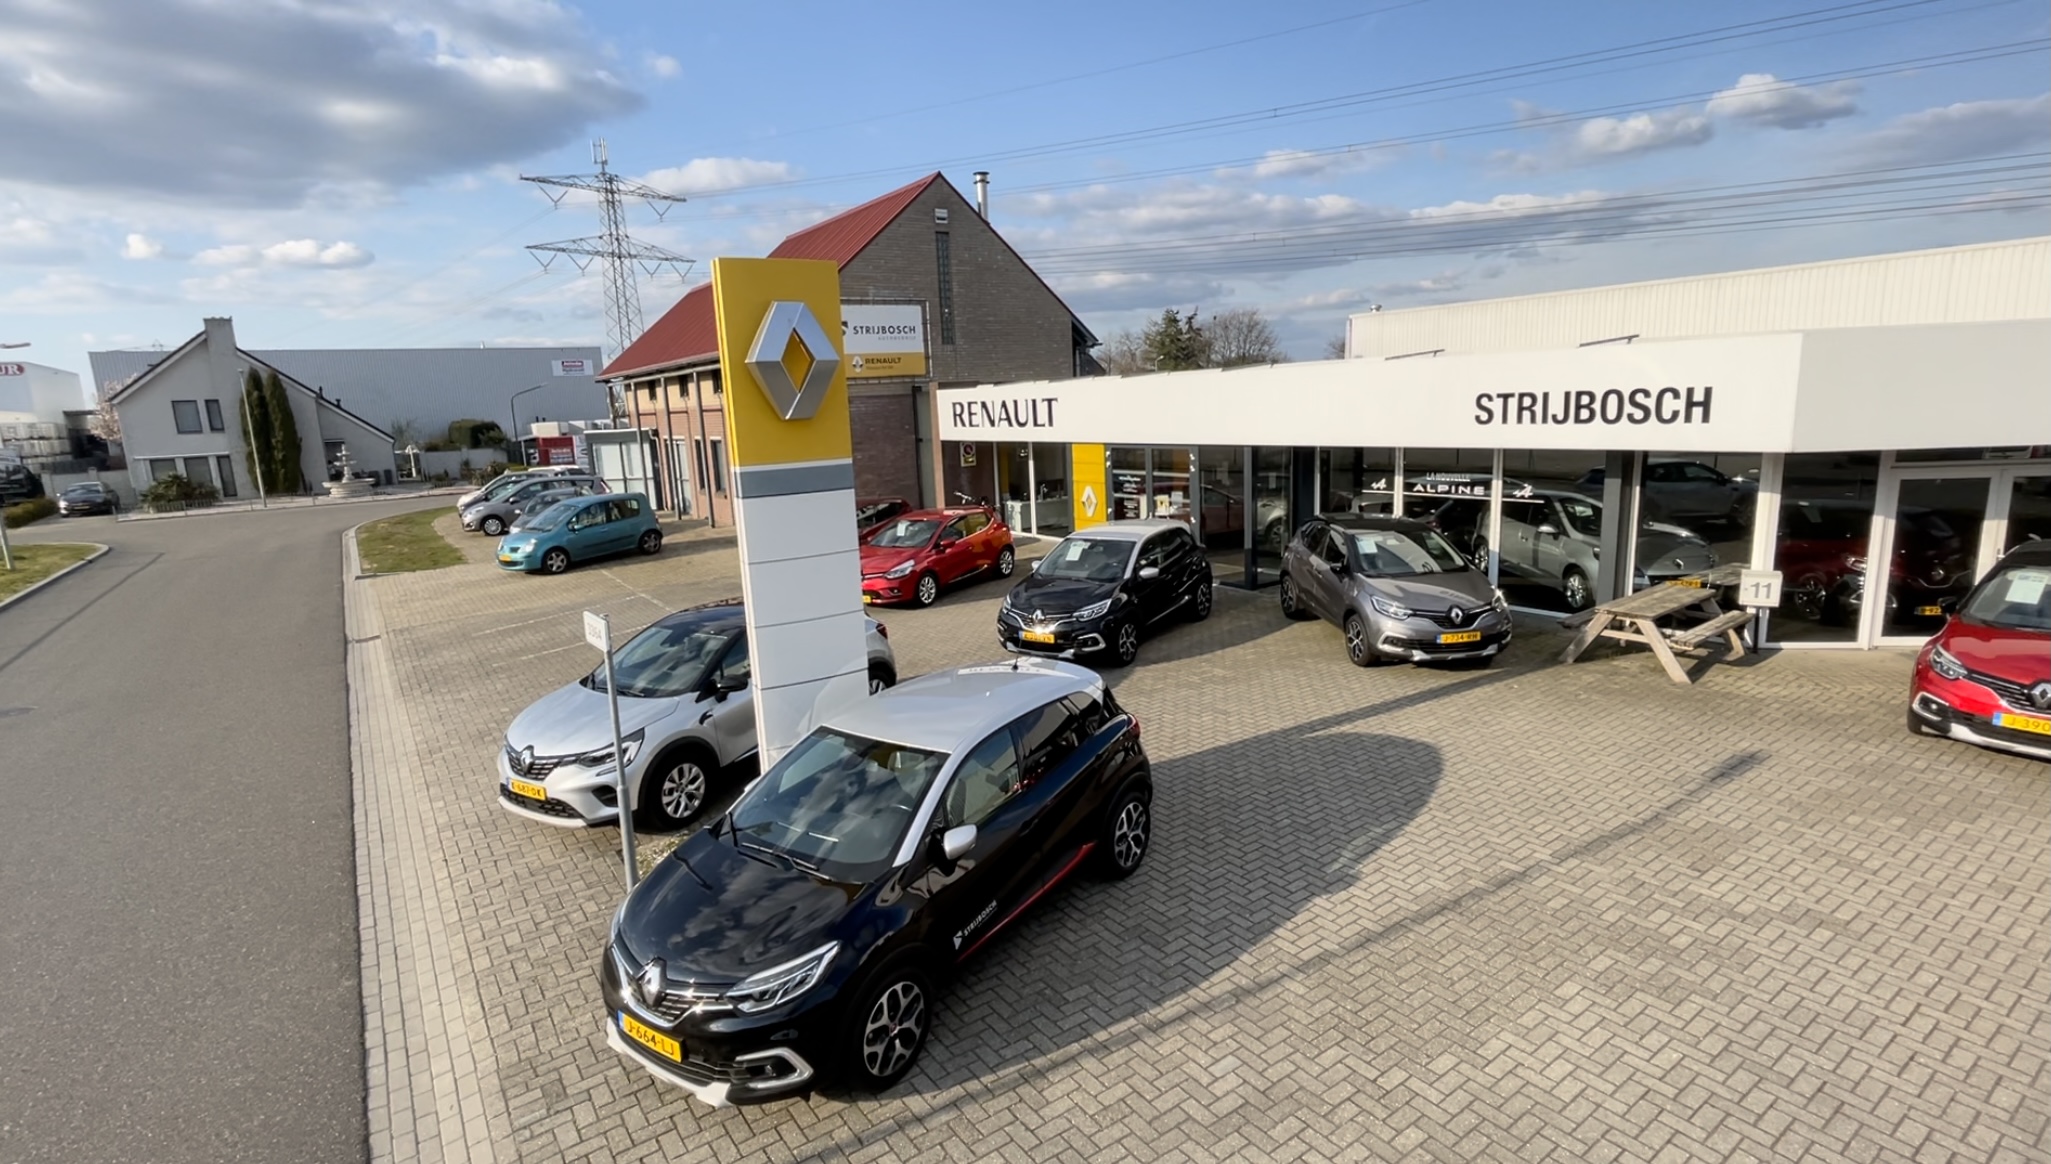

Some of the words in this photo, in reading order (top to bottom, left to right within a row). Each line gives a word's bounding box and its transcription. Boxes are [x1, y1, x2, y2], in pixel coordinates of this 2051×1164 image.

[853, 325, 916, 335] STRIJBOSCH
[865, 357, 902, 365] RENAULT
[952, 398, 1058, 427] RENAULT
[1475, 387, 1713, 425] STRIJBOSCH
[1413, 483, 1485, 496] ALPINE
[1751, 582, 1772, 599] 11
